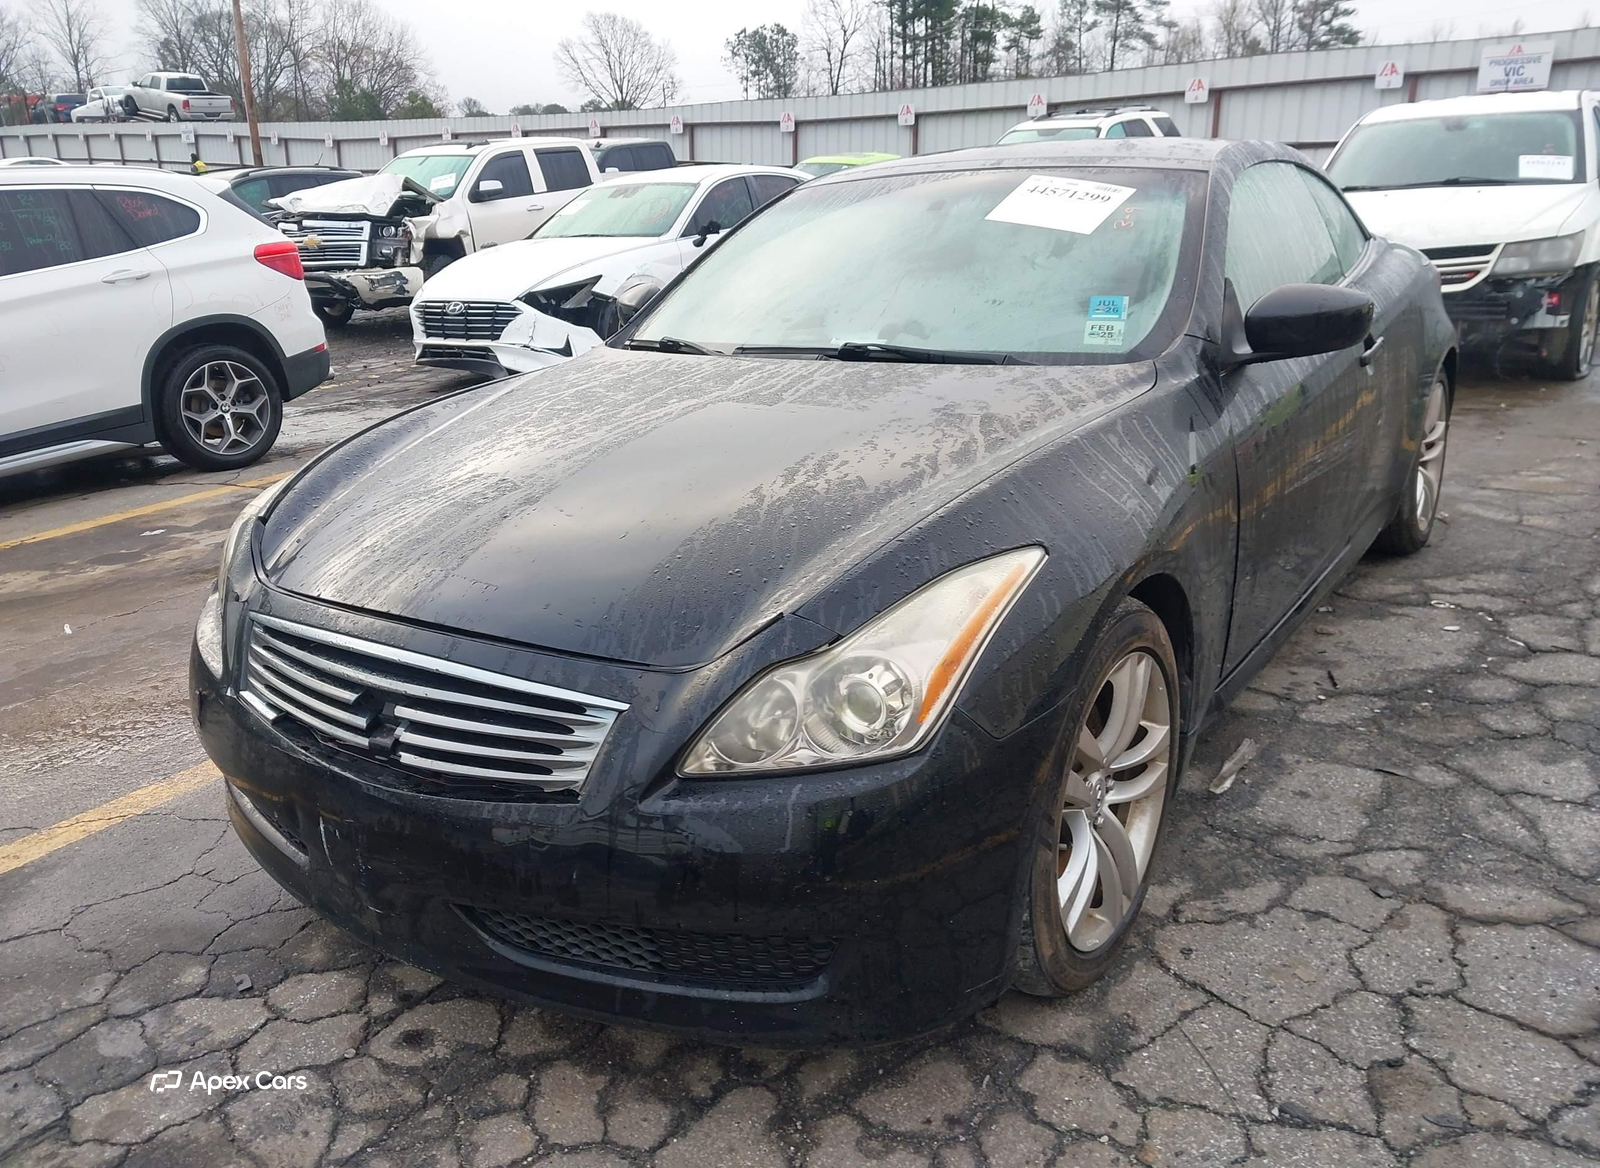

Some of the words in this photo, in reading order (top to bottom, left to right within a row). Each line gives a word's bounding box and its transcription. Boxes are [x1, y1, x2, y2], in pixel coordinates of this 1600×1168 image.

[1489, 55, 1543, 67] PROGRESSIVE
[1504, 65, 1525, 77] VIC
[1513, 77, 1534, 86] AREA
[1027, 184, 1112, 204] 44571299
